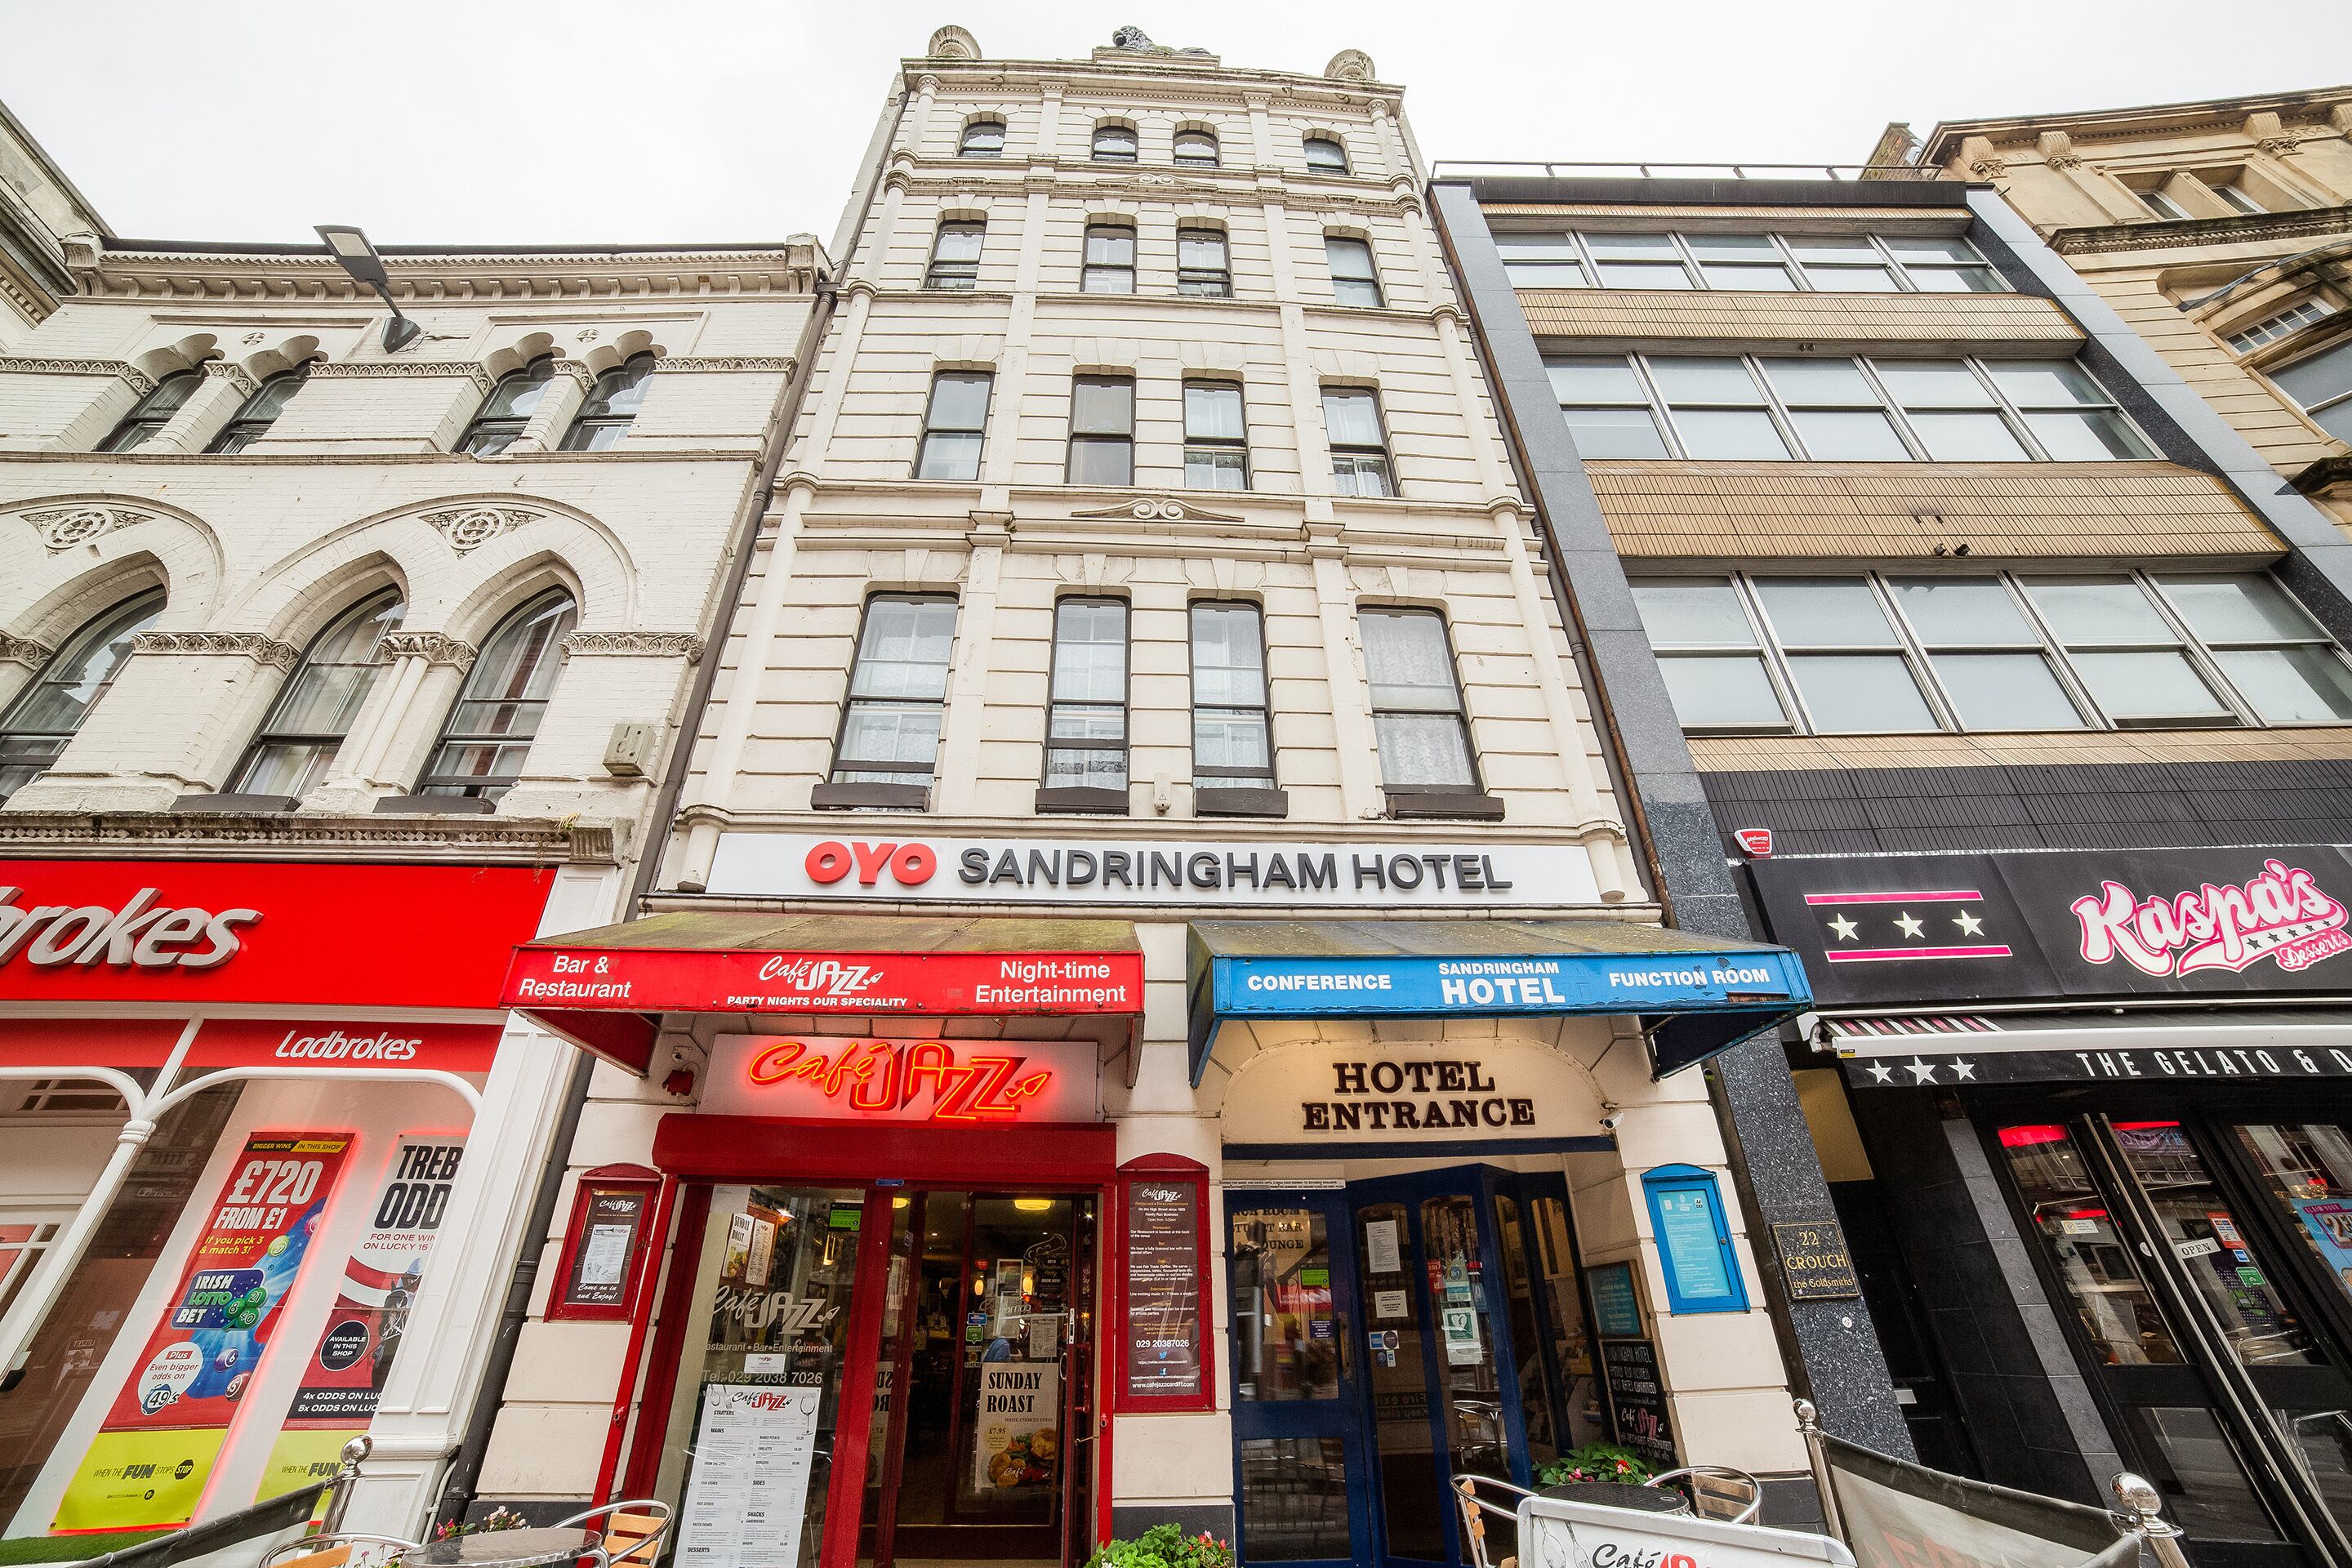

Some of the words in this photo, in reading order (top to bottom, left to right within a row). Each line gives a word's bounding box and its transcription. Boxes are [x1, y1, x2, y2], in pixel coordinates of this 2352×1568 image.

[804, 840, 937, 886] OYO
[957, 847, 1338, 889] SANDRINGHAM
[1352, 853, 1513, 890] HOTEL
[2070, 858, 2349, 978] Kaspa's
[2277, 929, 2352, 972] Desserts
[552, 956, 590, 973] Bar
[594, 956, 608, 973] &
[1000, 960, 1111, 983] Night-time
[1438, 961, 1560, 976] SANDRINGHAM
[759, 956, 813, 984] Café
[795, 960, 872, 996] JAZZ
[1247, 974, 1392, 991] CONFERENCE
[1610, 970, 1708, 987] FUNCTION
[1713, 968, 1771, 984] ROOM
[518, 978, 632, 999] Restaurant
[975, 984, 1126, 1004] Entertainment
[1441, 978, 1566, 1004] HOTEL
[726, 996, 765, 1006] PARTY
[767, 996, 811, 1006] NIGHTS
[812, 996, 839, 1007] OUR
[840, 997, 908, 1007] SPECIALITY
[275, 1030, 423, 1061] Ladbrokes
[2075, 1051, 2142, 1077] THE
[2153, 1049, 2281, 1076] GELATO
[2292, 1049, 2320, 1074] &
[748, 1042, 893, 1098] Café
[849, 1042, 1028, 1121] JAZZ
[1332, 1061, 1496, 1094] HOTEL
[1302, 1098, 1536, 1131] ENTRANCE
[396, 1145, 464, 1181] TREB
[225, 1160, 324, 1205] £720
[373, 1182, 454, 1230] ODD
[212, 1207, 265, 1230] FROM
[261, 1207, 288, 1230] £1
[204, 1236, 215, 1245] If
[215, 1236, 234, 1246] you
[234, 1235, 256, 1246] pick
[256, 1235, 265, 1244] 3
[370, 1233, 392, 1241] FOR
[393, 1233, 416, 1241] ONE
[1799, 1231, 1820, 1246] 22
[198, 1245, 206, 1254] &
[205, 1245, 240, 1255] match
[363, 1242, 380, 1250] ON
[380, 1242, 416, 1251] LUCKY
[418, 1243, 429, 1251] 15
[2180, 1242, 2212, 1256] OPEN
[1786, 1254, 1847, 1270] CROUCH
[194, 1275, 235, 1290] IRISH
[577, 1283, 598, 1291] Come
[1793, 1278, 1808, 1289] the
[1808, 1276, 1854, 1288] Goldsmiths
[187, 1290, 233, 1306] LOTTO
[247, 1291, 262, 1303] 21
[591, 1292, 617, 1301] Enjoy!
[176, 1308, 207, 1324] BET
[229, 1302, 240, 1314] 8
[743, 1291, 826, 1334] JAZZ
[706, 1343, 746, 1352] estaurant
[753, 1343, 769, 1352] Bar
[773, 1343, 833, 1353] Entertainment
[1136, 1339, 1151, 1348] 029
[1152, 1339, 1190, 1348] 20387026
[168, 1351, 189, 1359] Plus
[149, 1363, 168, 1372] Even
[169, 1363, 199, 1374] bigger
[152, 1372, 172, 1381] odds
[727, 1371, 751, 1383] 029
[755, 1373, 787, 1384] 2038
[791, 1371, 823, 1384] 7026
[988, 1372, 1042, 1390] SUNDAY
[302, 1392, 316, 1401] 4x
[316, 1392, 346, 1401] ODDS
[347, 1392, 363, 1401] ON
[732, 1391, 760, 1406] Café
[751, 1392, 788, 1411] JAZZ
[987, 1395, 1035, 1413] ROAST
[297, 1404, 310, 1412] 5x
[310, 1404, 341, 1412] ODDS
[341, 1404, 357, 1412] ON
[1621, 1407, 1636, 1428] Café
[93, 1468, 112, 1477] WHEN
[111, 1468, 125, 1477] THE
[122, 1463, 158, 1480] FUN
[175, 1464, 193, 1475] STOP
[281, 1465, 298, 1474] WHEN
[307, 1462, 341, 1477] FUN
